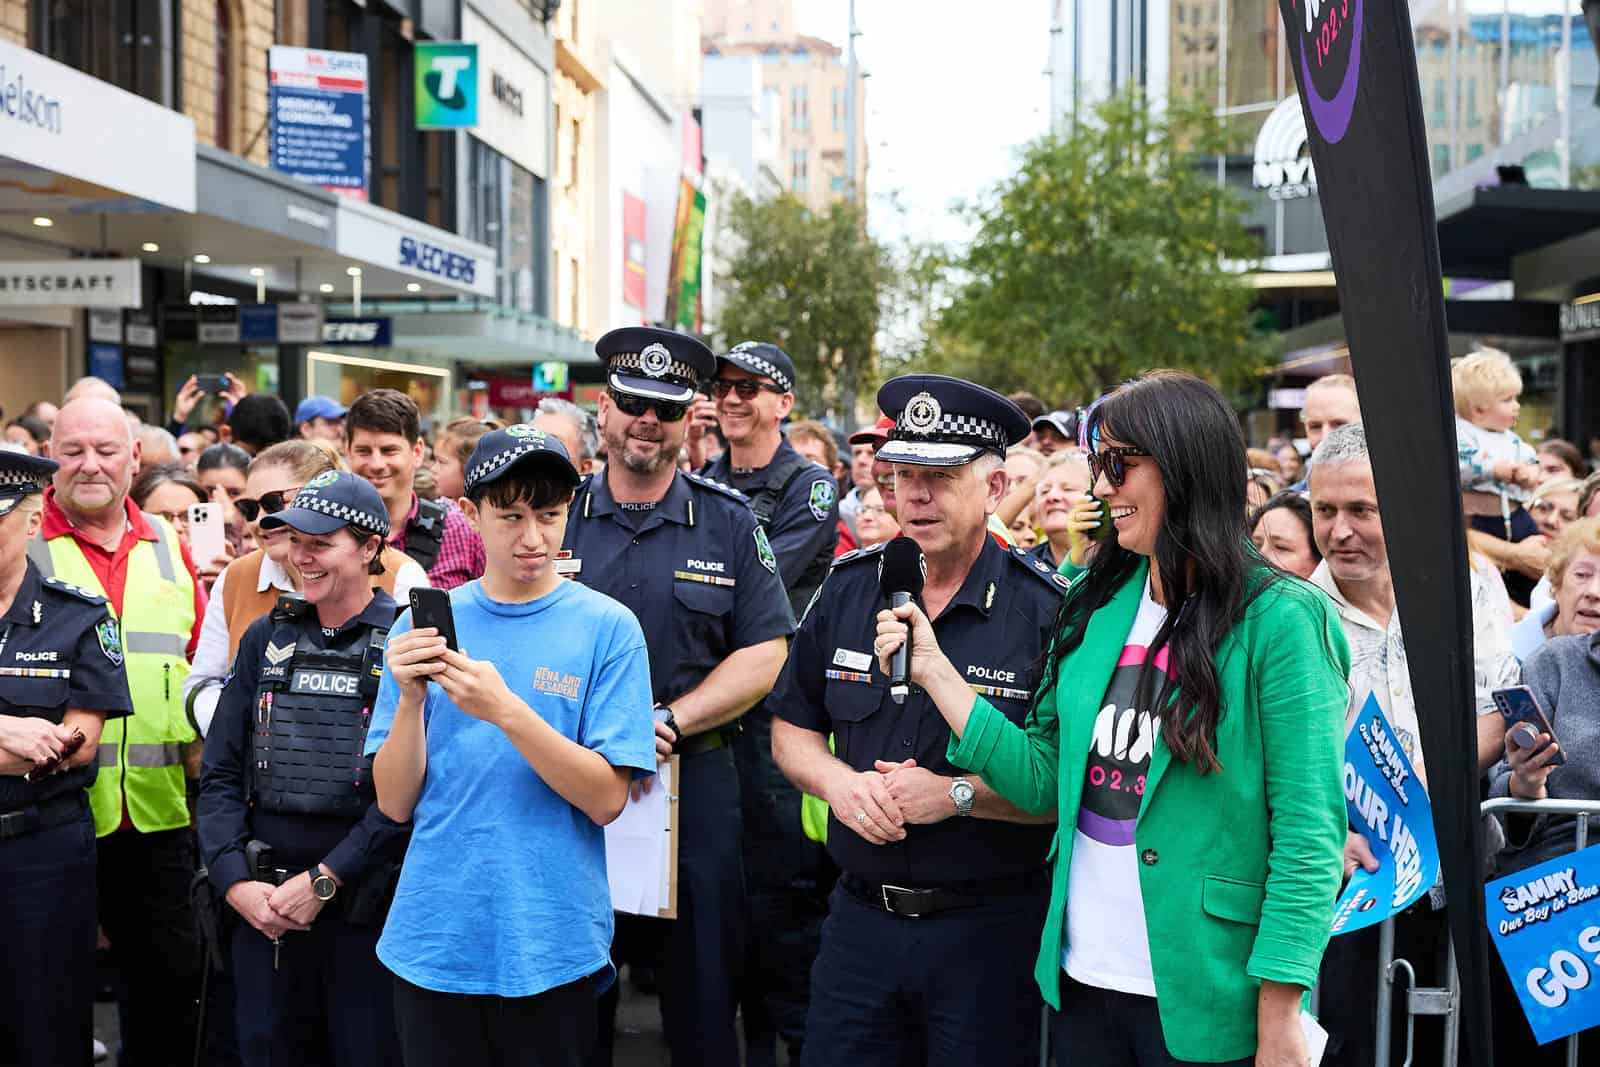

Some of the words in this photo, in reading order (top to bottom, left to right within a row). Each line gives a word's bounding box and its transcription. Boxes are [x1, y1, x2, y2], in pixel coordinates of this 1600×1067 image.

[400, 236, 476, 285] SKECHERS
[621, 503, 656, 511] POLICE
[687, 559, 725, 572] POLICE
[15, 651, 58, 661] POLICE
[967, 664, 1016, 683] POLICE
[298, 674, 359, 694] POLICE
[1502, 868, 1576, 912] SAMMY
[1500, 918, 1524, 934] Our
[1524, 906, 1550, 922] Boy
[1567, 884, 1600, 904] Blue
[1526, 950, 1589, 1008] GO
